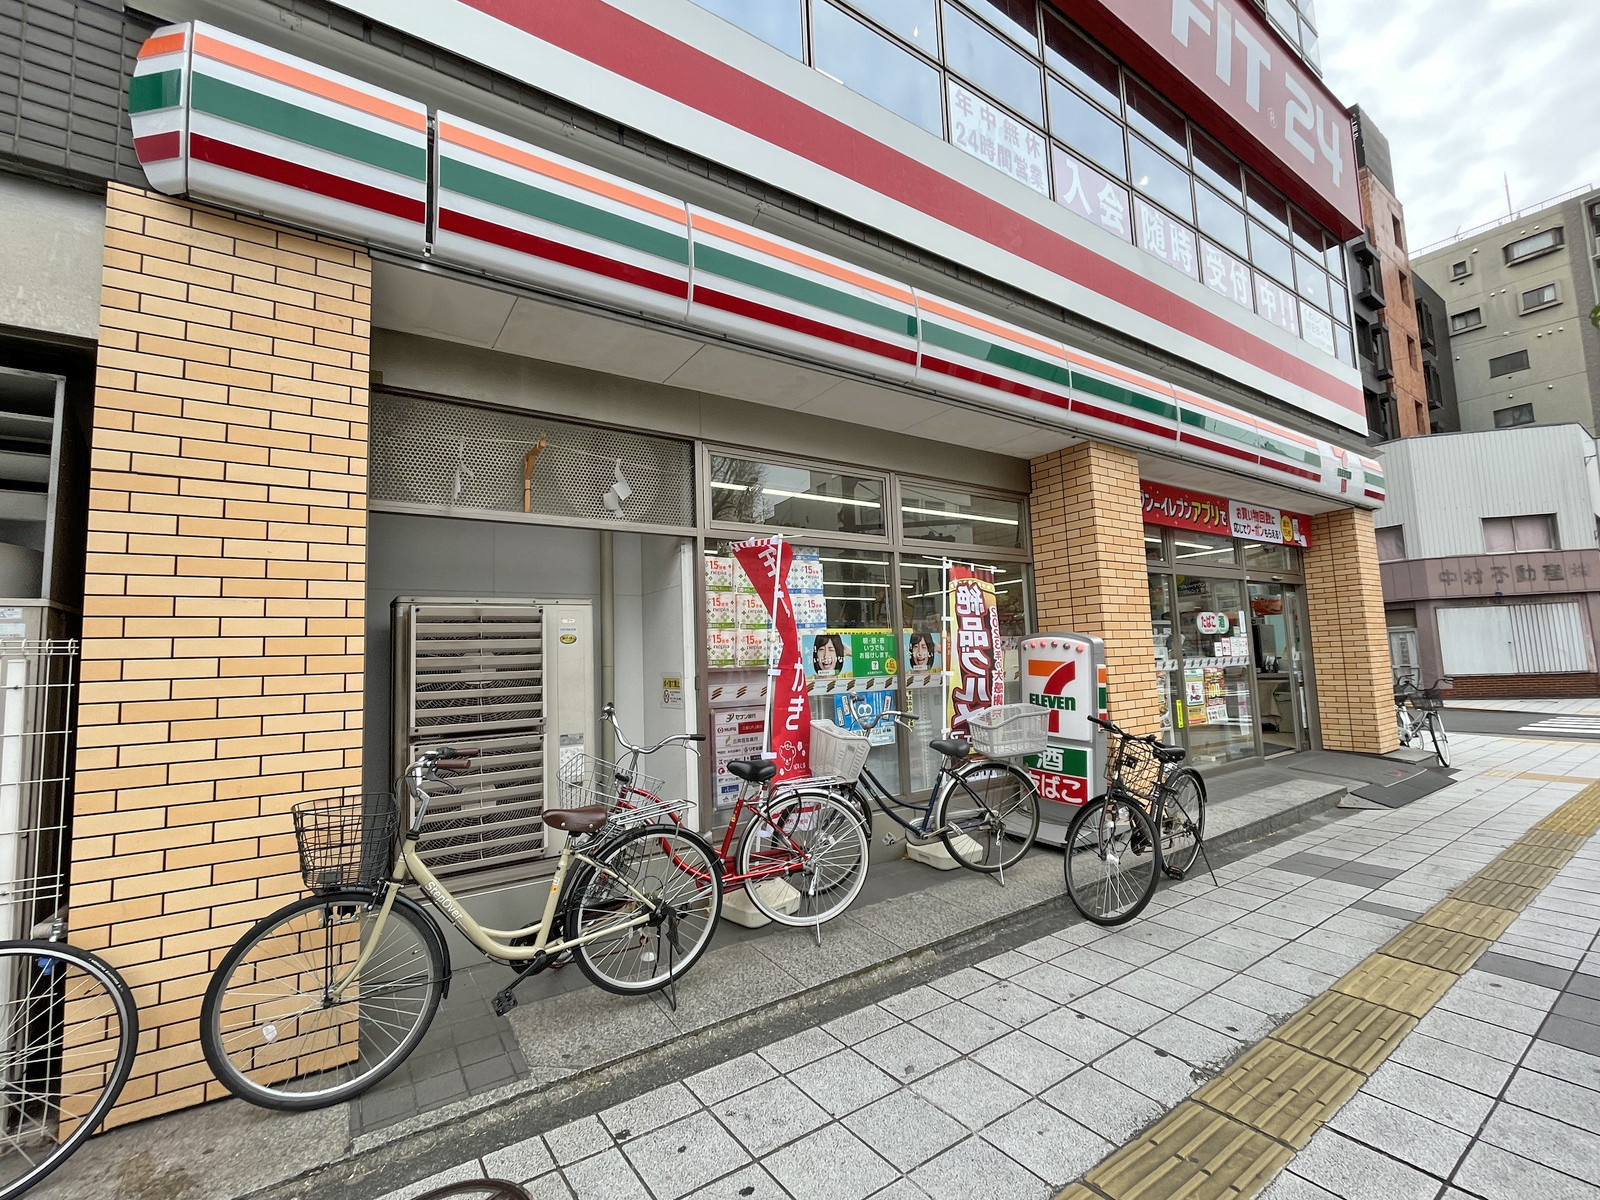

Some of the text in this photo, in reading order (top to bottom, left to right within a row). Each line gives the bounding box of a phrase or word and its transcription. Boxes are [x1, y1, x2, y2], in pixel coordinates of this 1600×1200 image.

[1171, 0, 1343, 188] FIT 24
[954, 88, 1043, 158] 年中無休
[955, 120, 1046, 194] 24時間営業
[1236, 507, 1276, 525] お買い物回数に
[1200, 615, 1226, 628] たばこ 酒
[1036, 748, 1063, 772] 酒
[424, 881, 463, 920] StepOver
